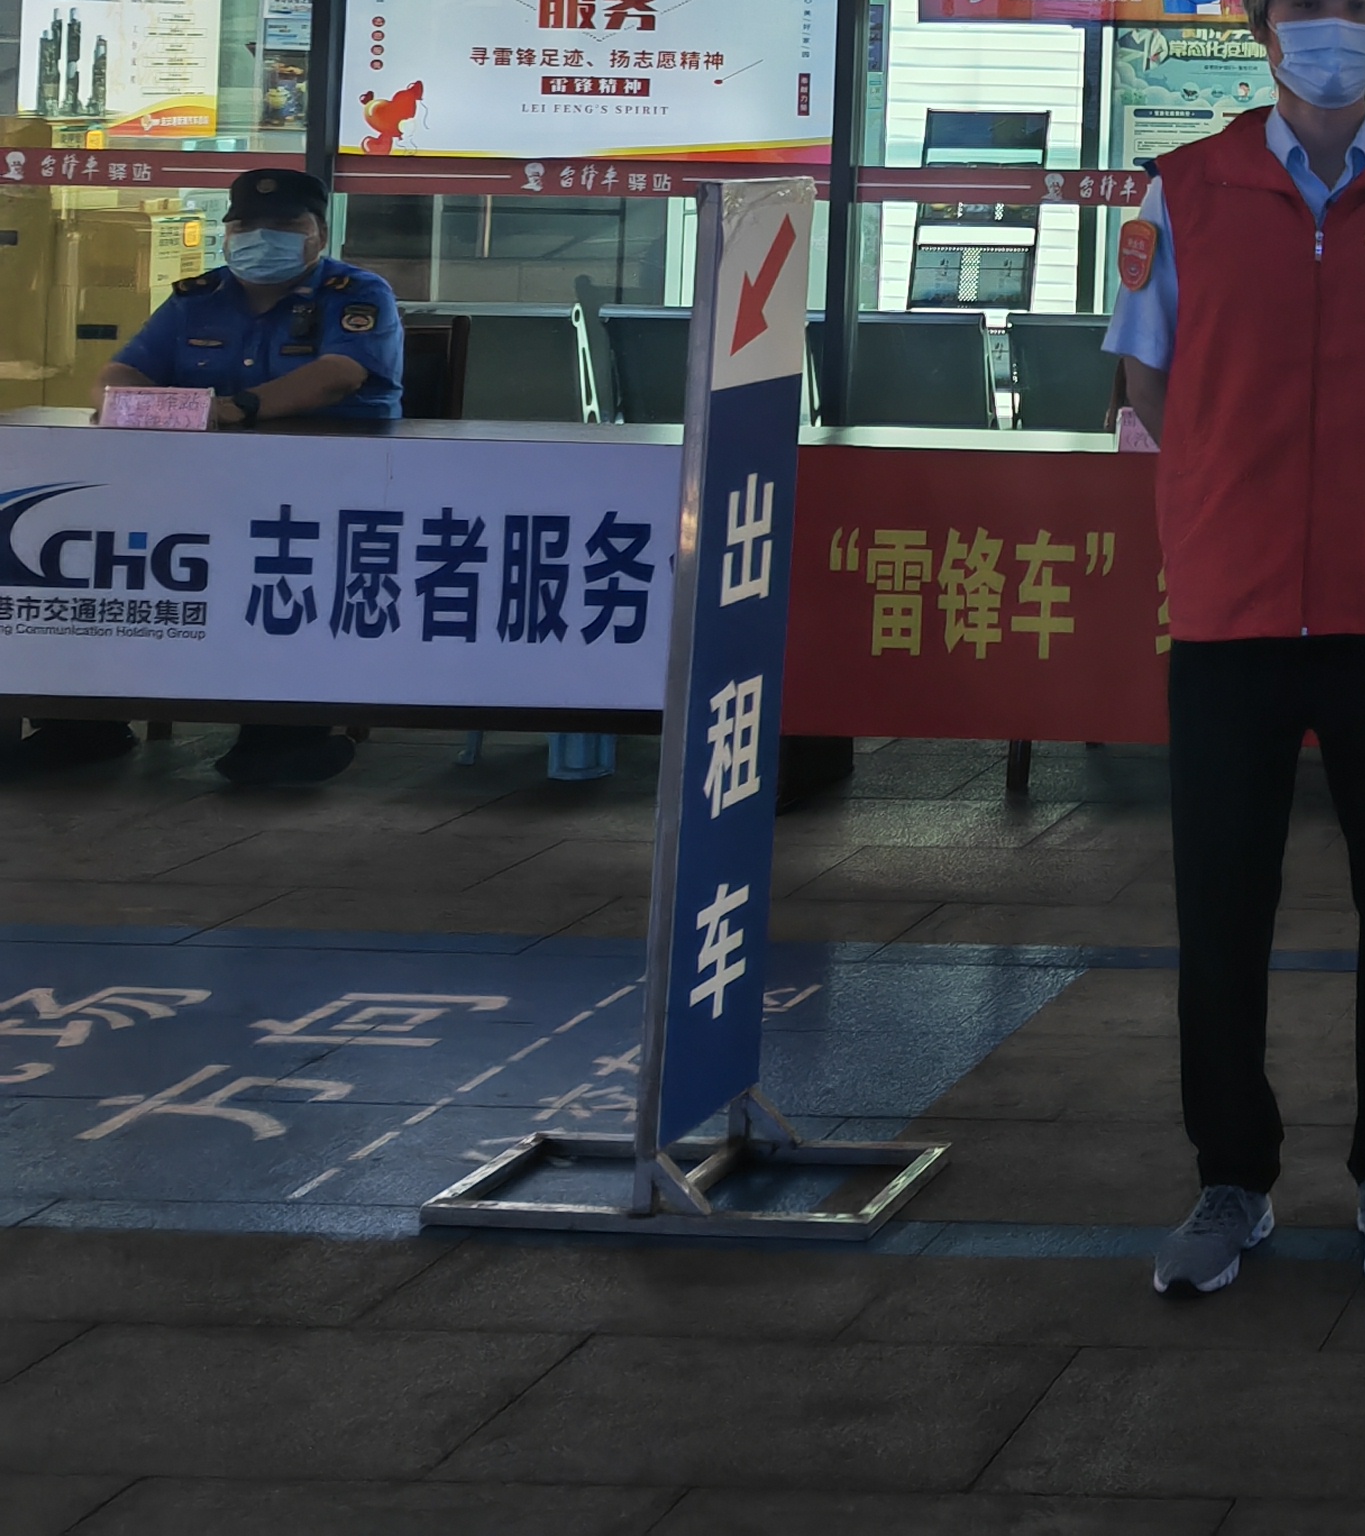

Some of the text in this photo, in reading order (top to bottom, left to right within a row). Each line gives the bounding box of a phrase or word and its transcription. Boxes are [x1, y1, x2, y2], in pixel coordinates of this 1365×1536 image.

[469, 47, 725, 72] 寻雷锋足迹、扬志愿精神
[549, 77, 643, 95] 雷锋精神
[521, 103, 546, 113] LEI
[615, 105, 669, 116] SPIRIT
[40, 529, 210, 592] CHG
[245, 504, 674, 646] 志愿者服务
[16, 624, 113, 637] Communication
[116, 627, 163, 640] Holding
[167, 628, 207, 641] Group
[690, 472, 776, 1020] 出租车
